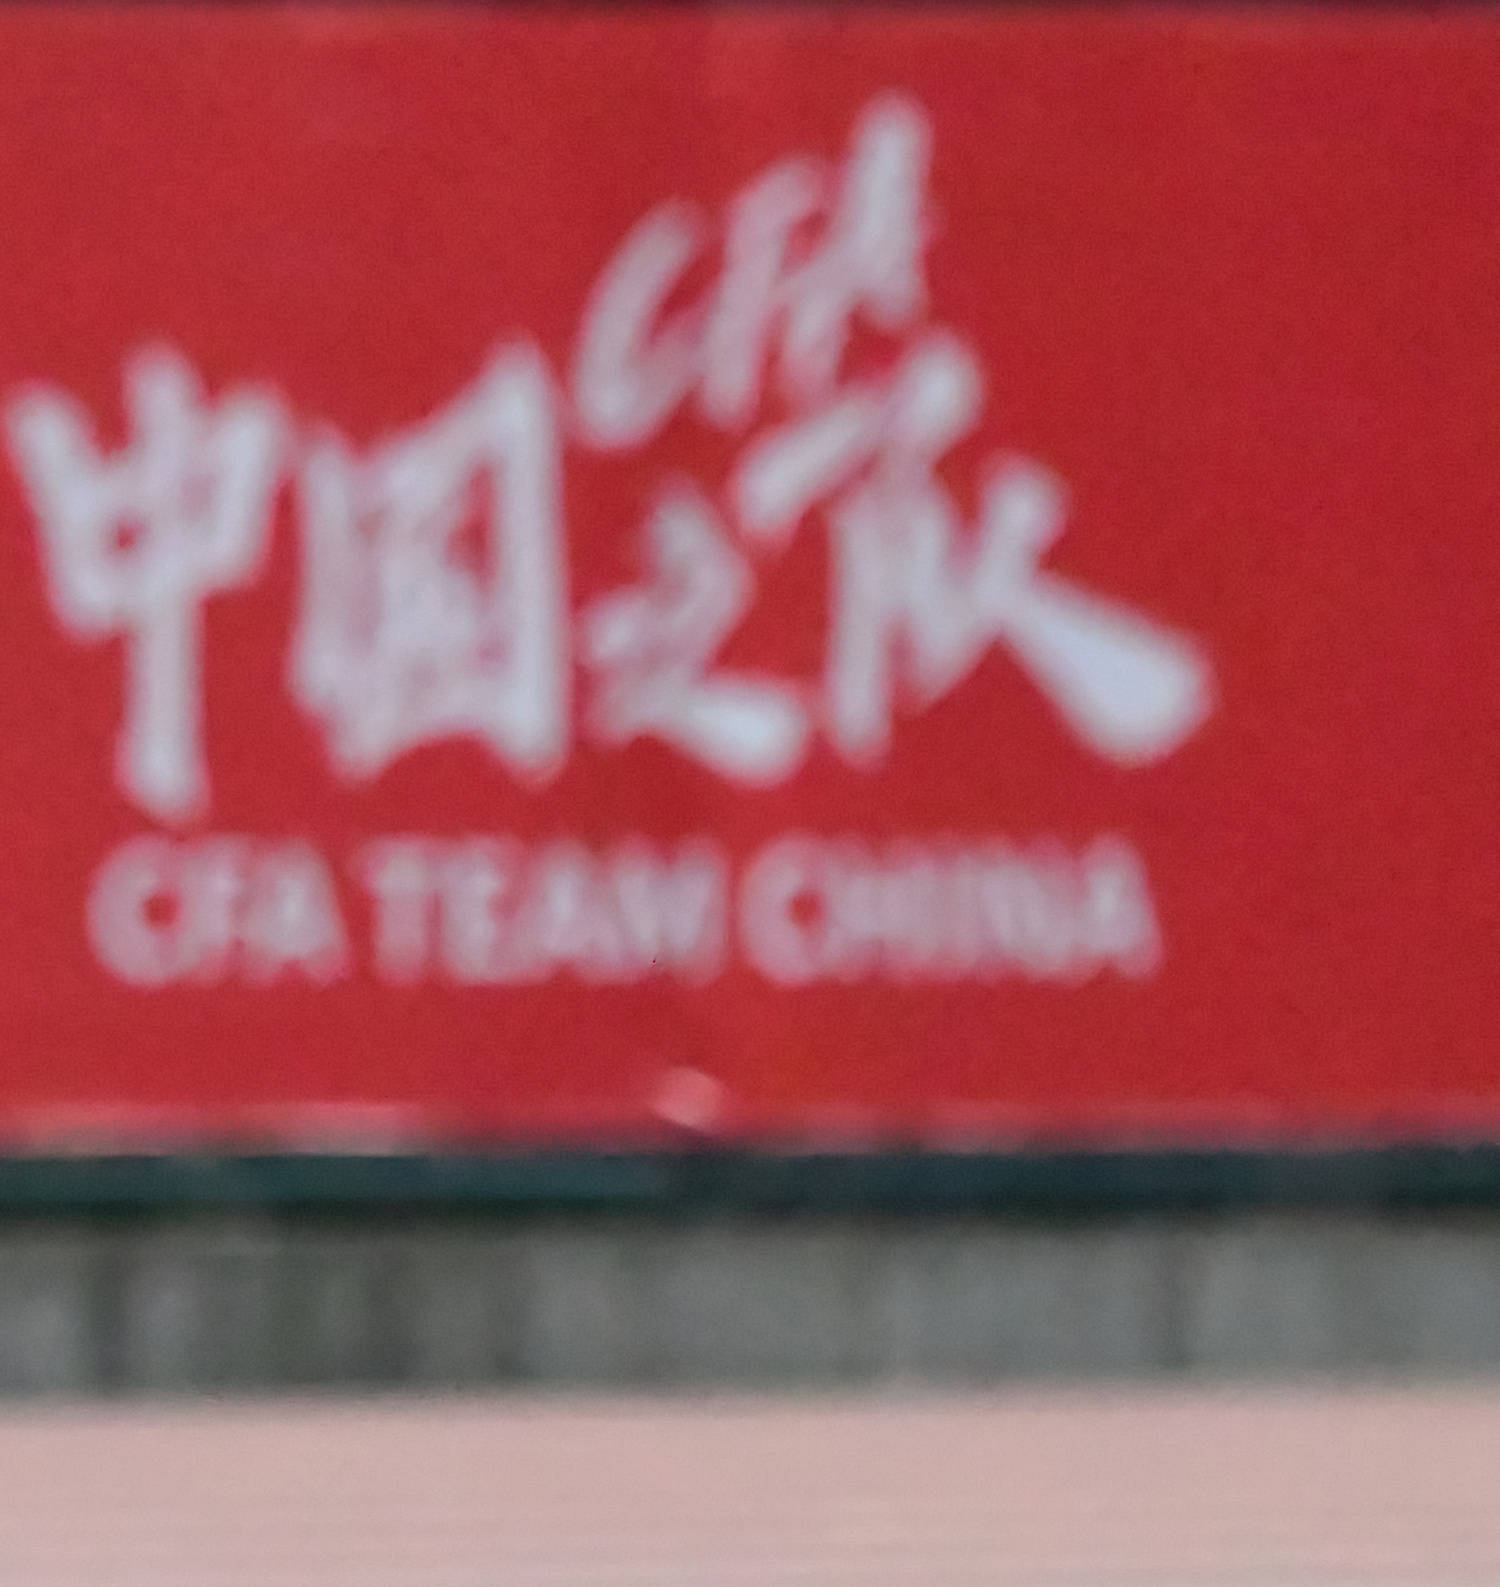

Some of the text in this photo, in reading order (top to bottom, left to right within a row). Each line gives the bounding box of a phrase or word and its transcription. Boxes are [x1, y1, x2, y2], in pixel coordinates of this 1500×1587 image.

[578, 96, 930, 444] CFA
[90, 838, 1156, 984] CFA TEAM CHINA
